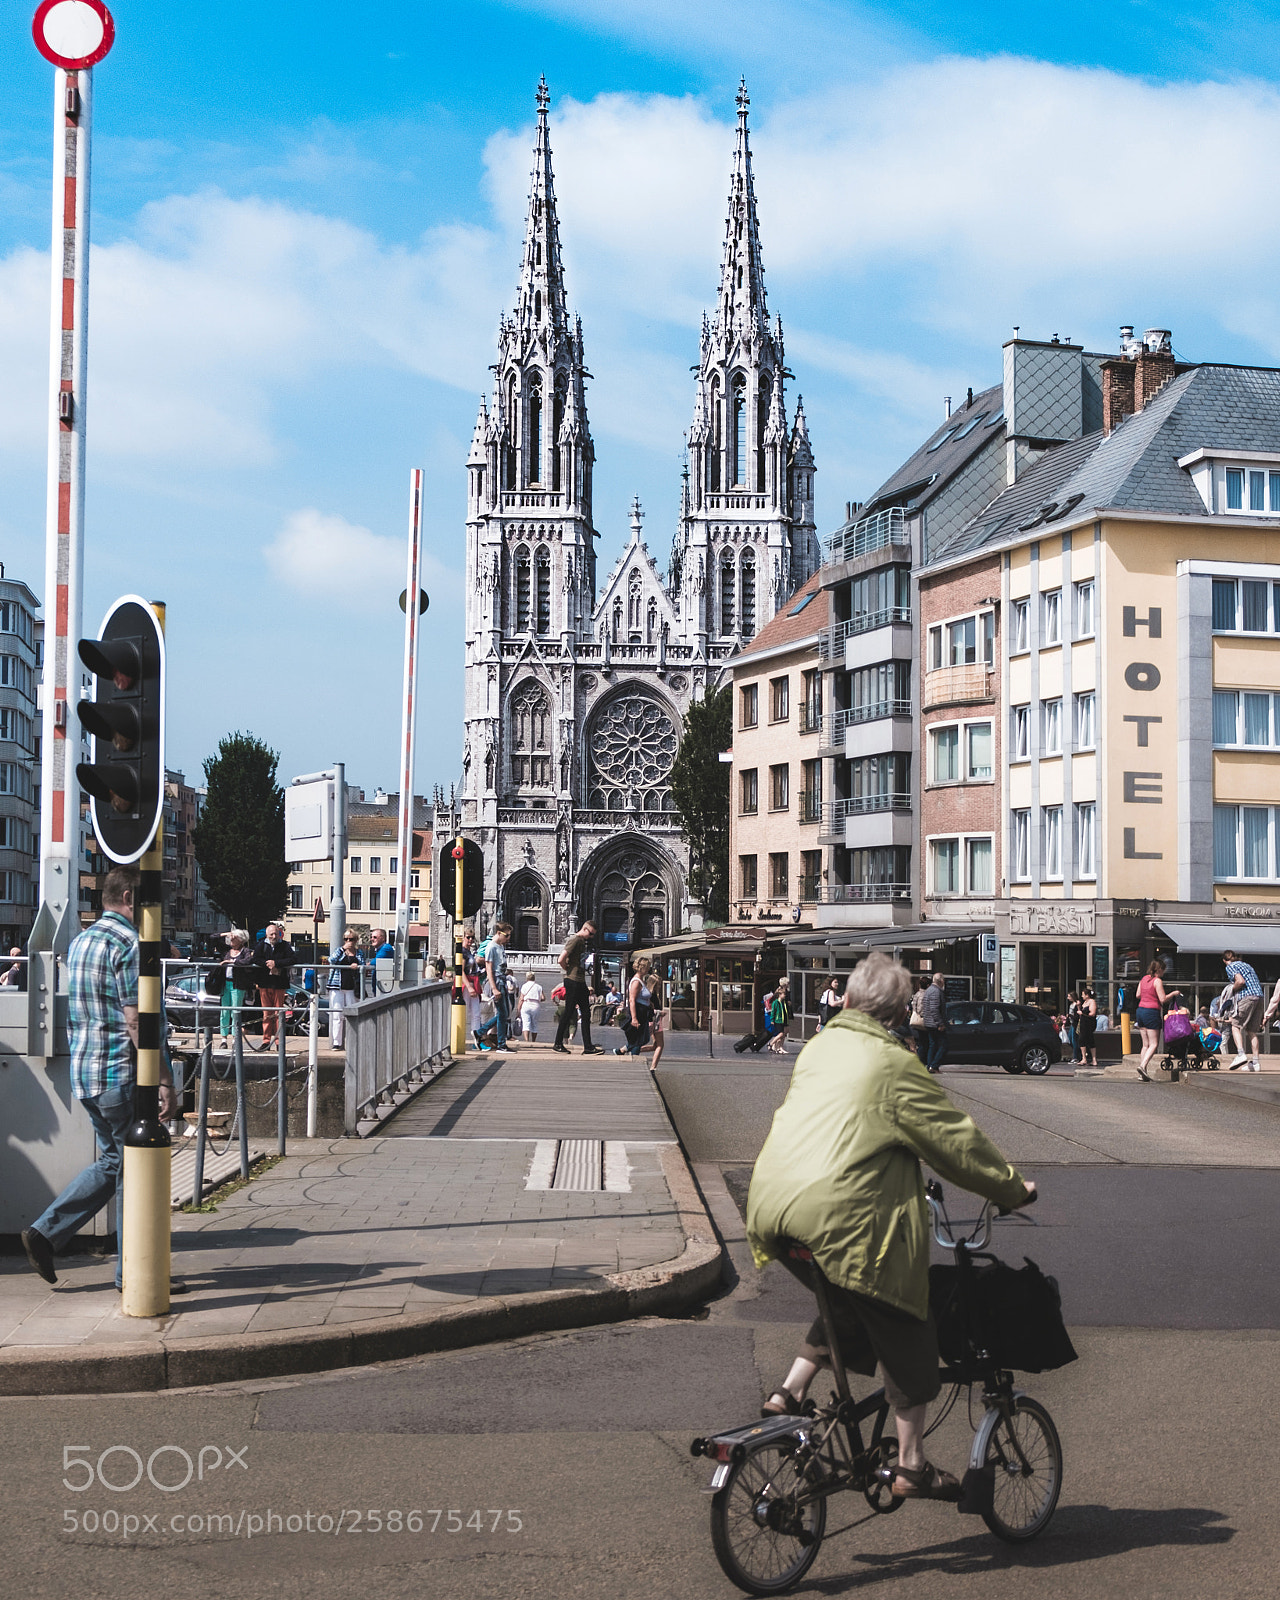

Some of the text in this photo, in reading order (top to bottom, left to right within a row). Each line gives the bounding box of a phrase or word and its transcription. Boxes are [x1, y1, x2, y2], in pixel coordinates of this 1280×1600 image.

[1122, 605, 1163, 860] HOTEL
[1225, 906, 1272, 918] TEAROOM
[1010, 915, 1094, 935] DU BASSIN
